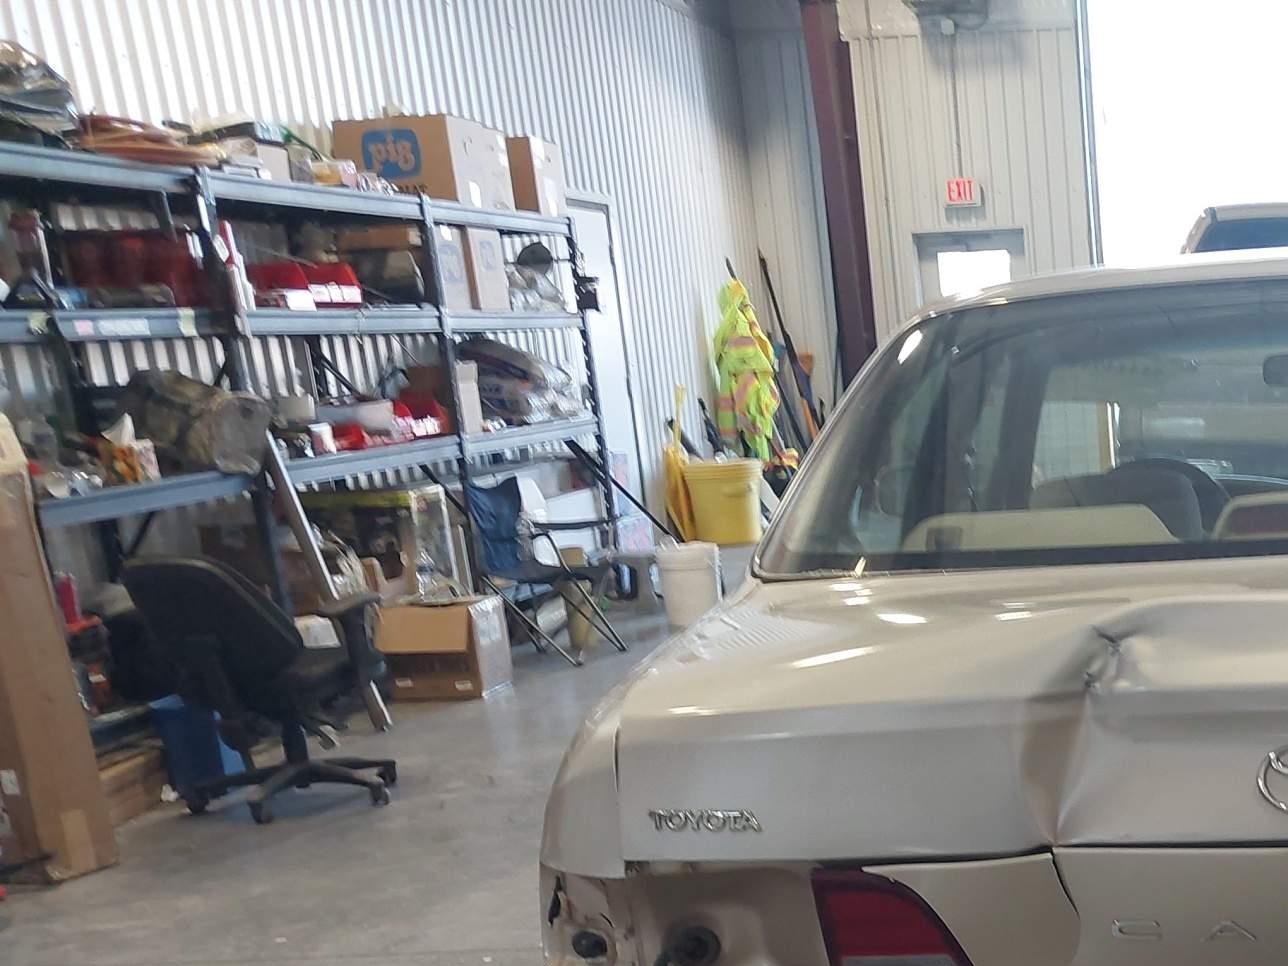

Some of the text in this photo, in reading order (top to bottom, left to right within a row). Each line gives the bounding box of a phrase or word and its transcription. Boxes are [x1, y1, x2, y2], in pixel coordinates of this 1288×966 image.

[367, 131, 416, 173] pig
[946, 179, 973, 202] EXIT
[648, 808, 764, 833] TOYOTA
